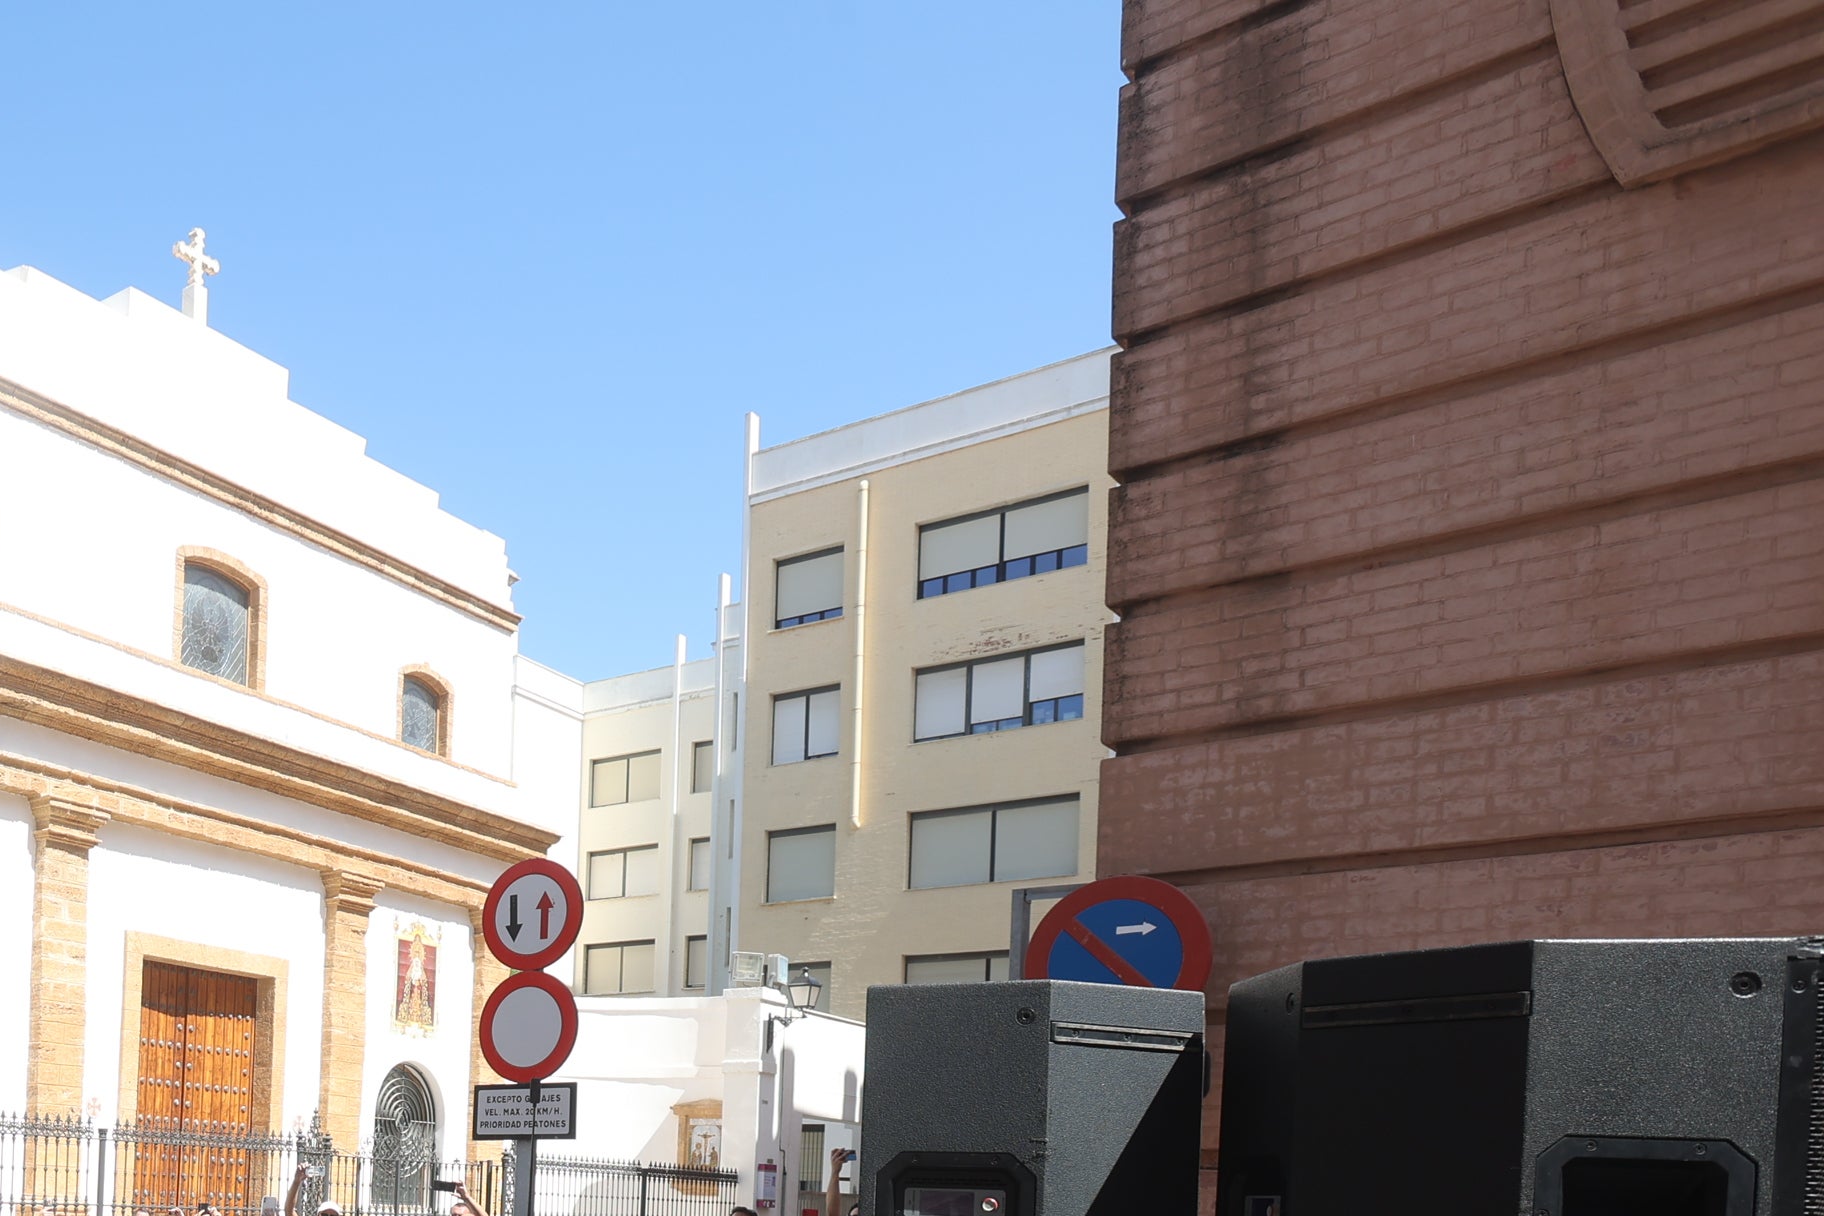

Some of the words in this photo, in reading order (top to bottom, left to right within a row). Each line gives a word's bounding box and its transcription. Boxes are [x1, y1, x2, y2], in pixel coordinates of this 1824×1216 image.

[486, 1095, 522, 1103] EXCEPTO
[525, 1094, 561, 1103] GAJES
[485, 1108, 501, 1116] VEL.
[503, 1108, 523, 1116] MAX.
[537, 1107, 563, 1115] KM/H.
[480, 1120, 521, 1128] PRIORIDAD
[523, 1120, 566, 1128] PEATONES
